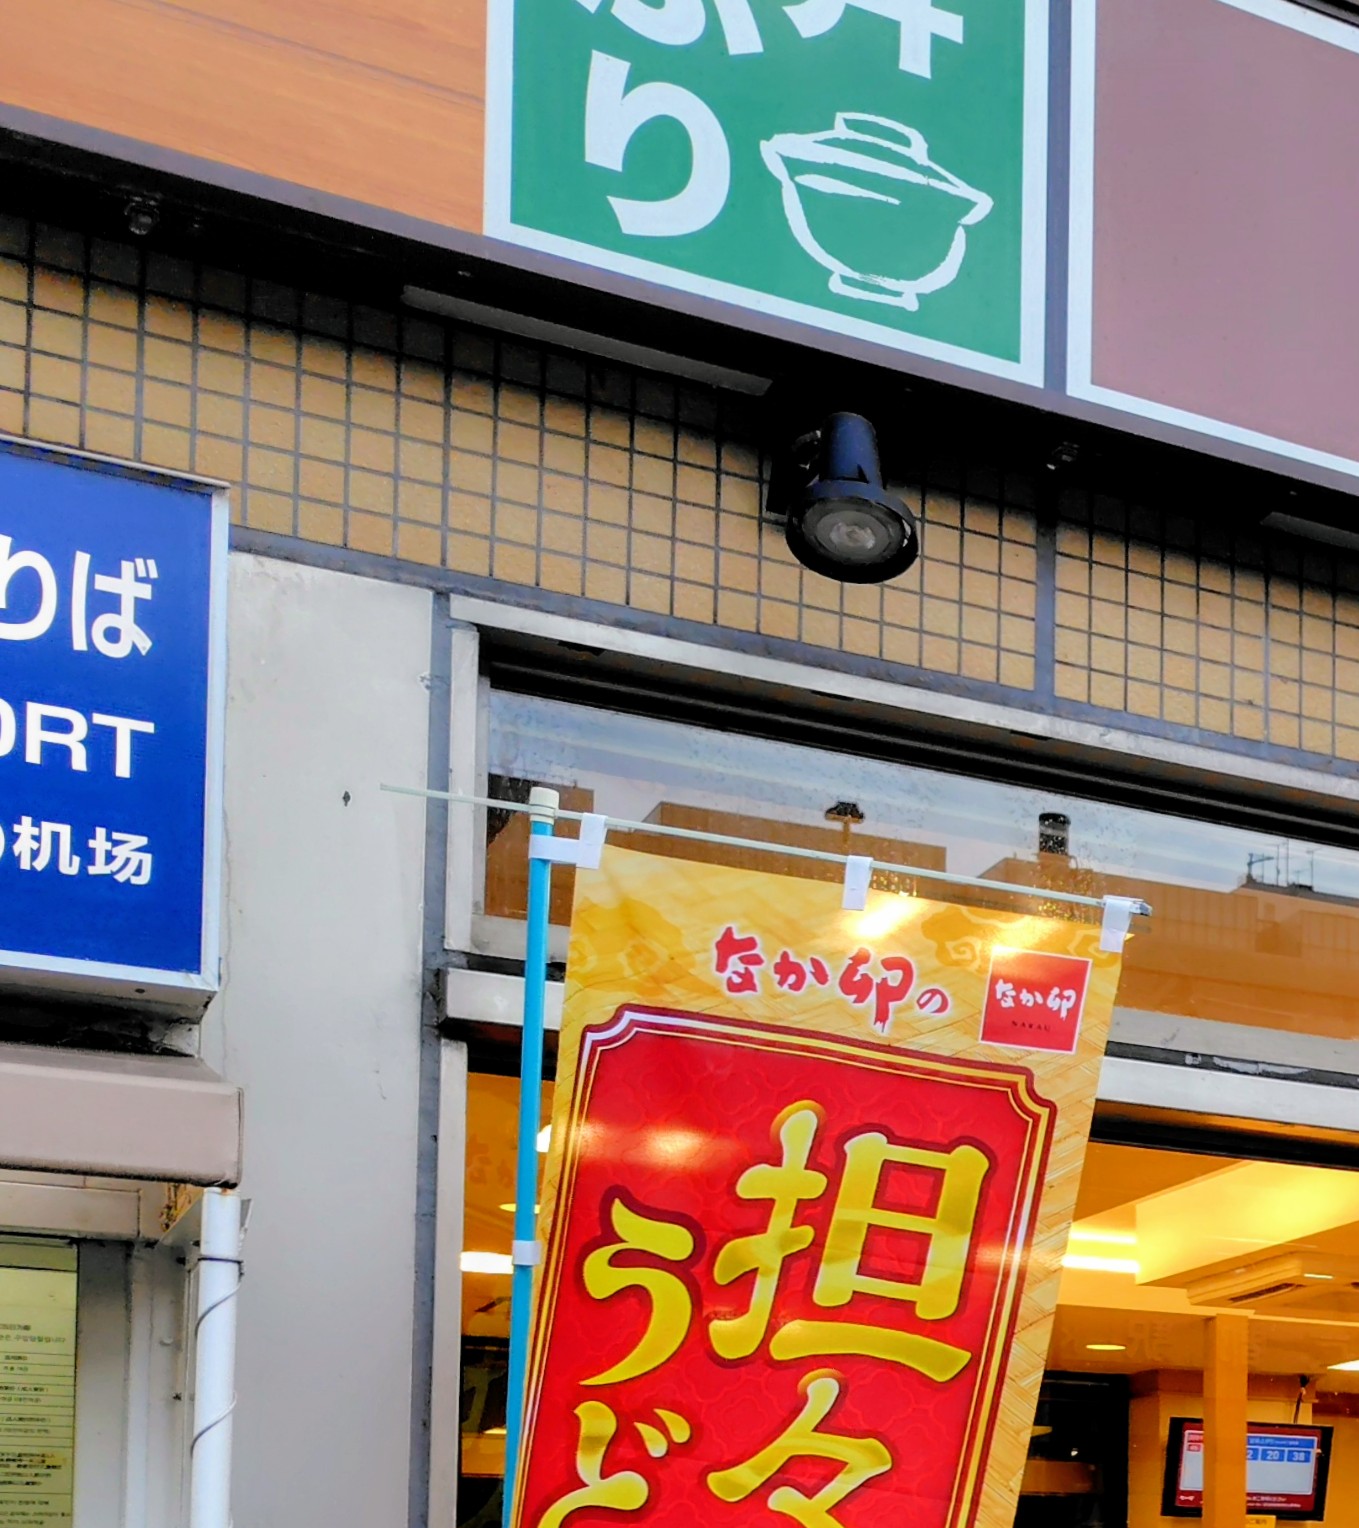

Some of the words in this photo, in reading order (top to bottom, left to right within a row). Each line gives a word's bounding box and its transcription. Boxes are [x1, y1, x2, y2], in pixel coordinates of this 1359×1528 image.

[0, 699, 155, 779] RT
[714, 926, 950, 1034] なか卯の
[994, 978, 1077, 1022] なか卯
